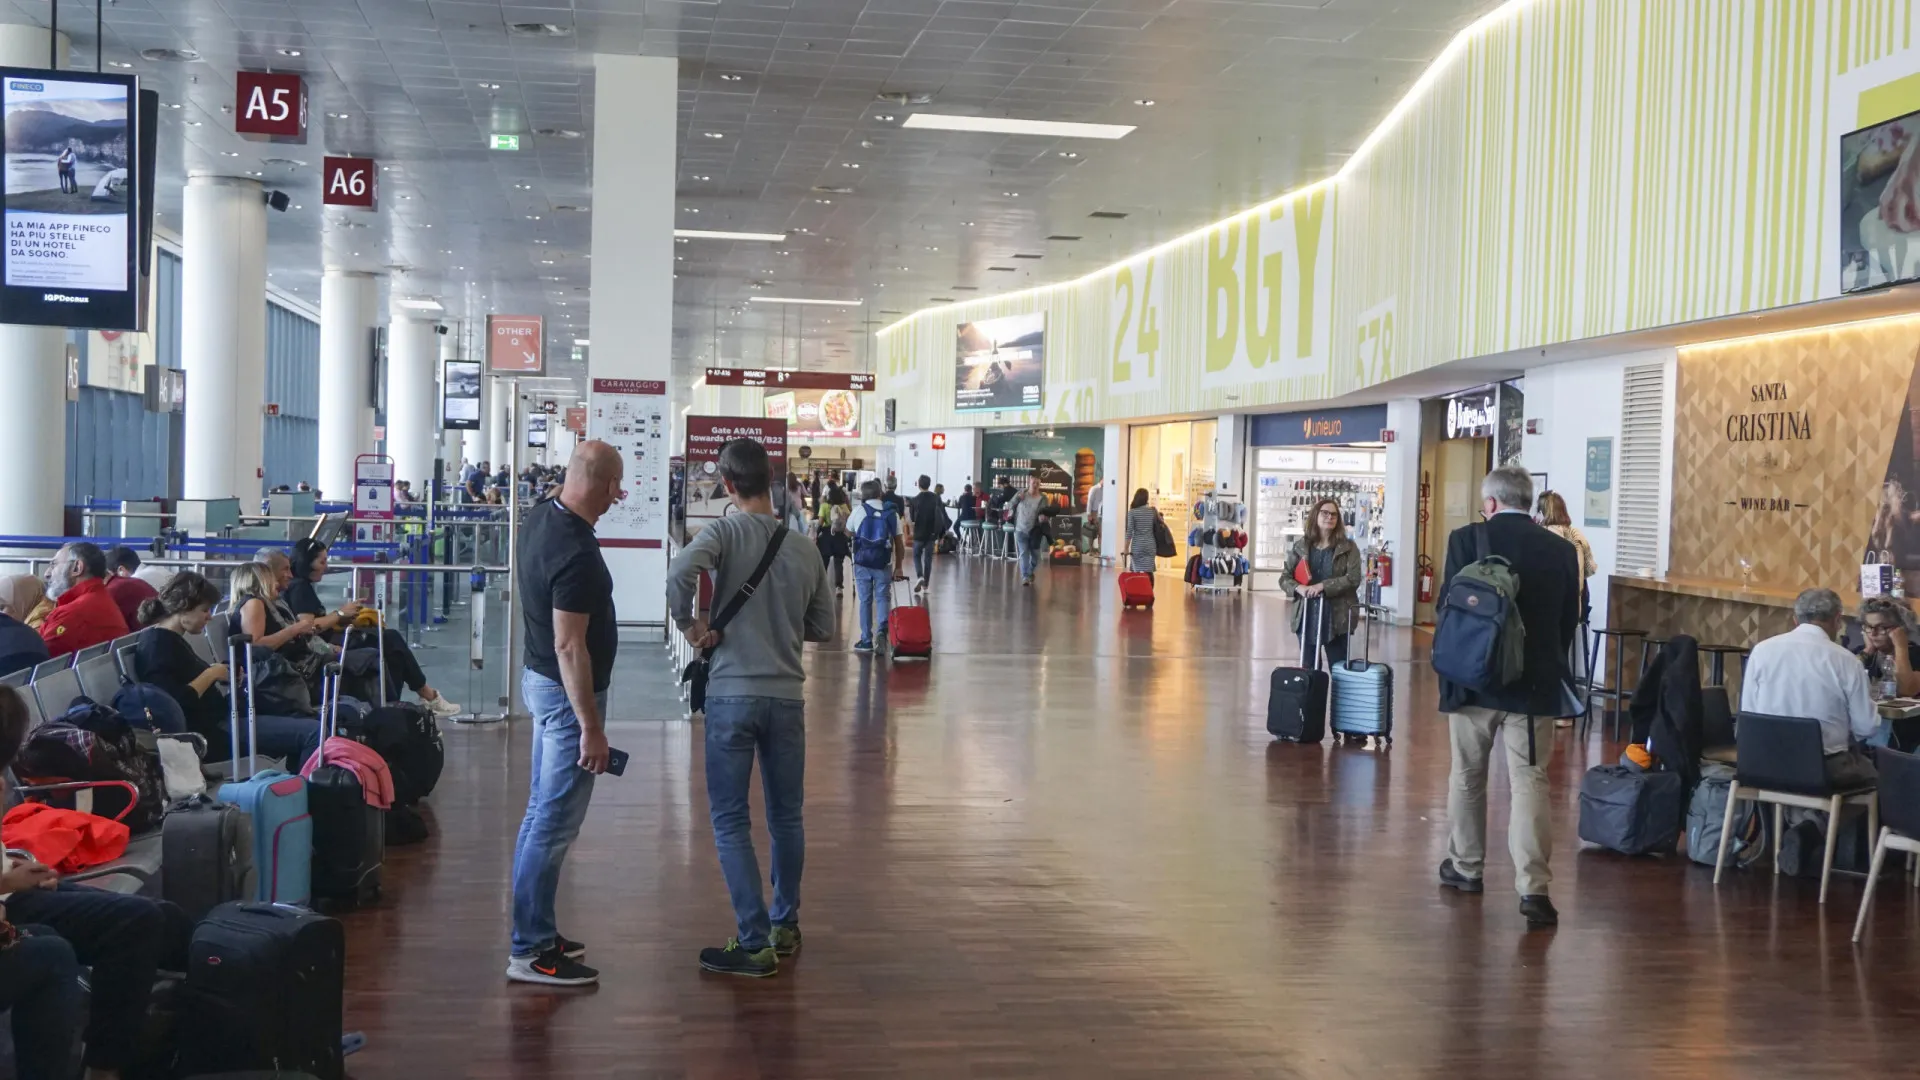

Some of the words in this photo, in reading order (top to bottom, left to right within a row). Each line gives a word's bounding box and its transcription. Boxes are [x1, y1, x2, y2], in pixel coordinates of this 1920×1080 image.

[12, 83, 42, 91] FINECO
[245, 86, 290, 121] A5
[330, 168, 366, 196] A6
[11, 221, 23, 229] LA
[73, 224, 111, 233] FINECO
[49, 233, 86, 241] STELLE
[25, 240, 40, 248] UN
[43, 241, 76, 250] HOTEL
[28, 250, 69, 258] SOGNO.
[1205, 186, 1327, 374] BGY
[1112, 256, 1160, 384] 24
[497, 327, 533, 336] OTHER
[67, 356, 79, 389] A5
[600, 380, 659, 389] CARAVAGGIO
[1751, 382, 1788, 402] SANTA
[711, 426, 732, 434] Gate
[733, 427, 763, 436] A9/A11
[1311, 416, 1342, 437] unieuro
[1726, 410, 1812, 443] CRISTINA
[690, 434, 724, 442] towards
[1740, 497, 1767, 511] WINE
[1769, 499, 1790, 512] BAR
